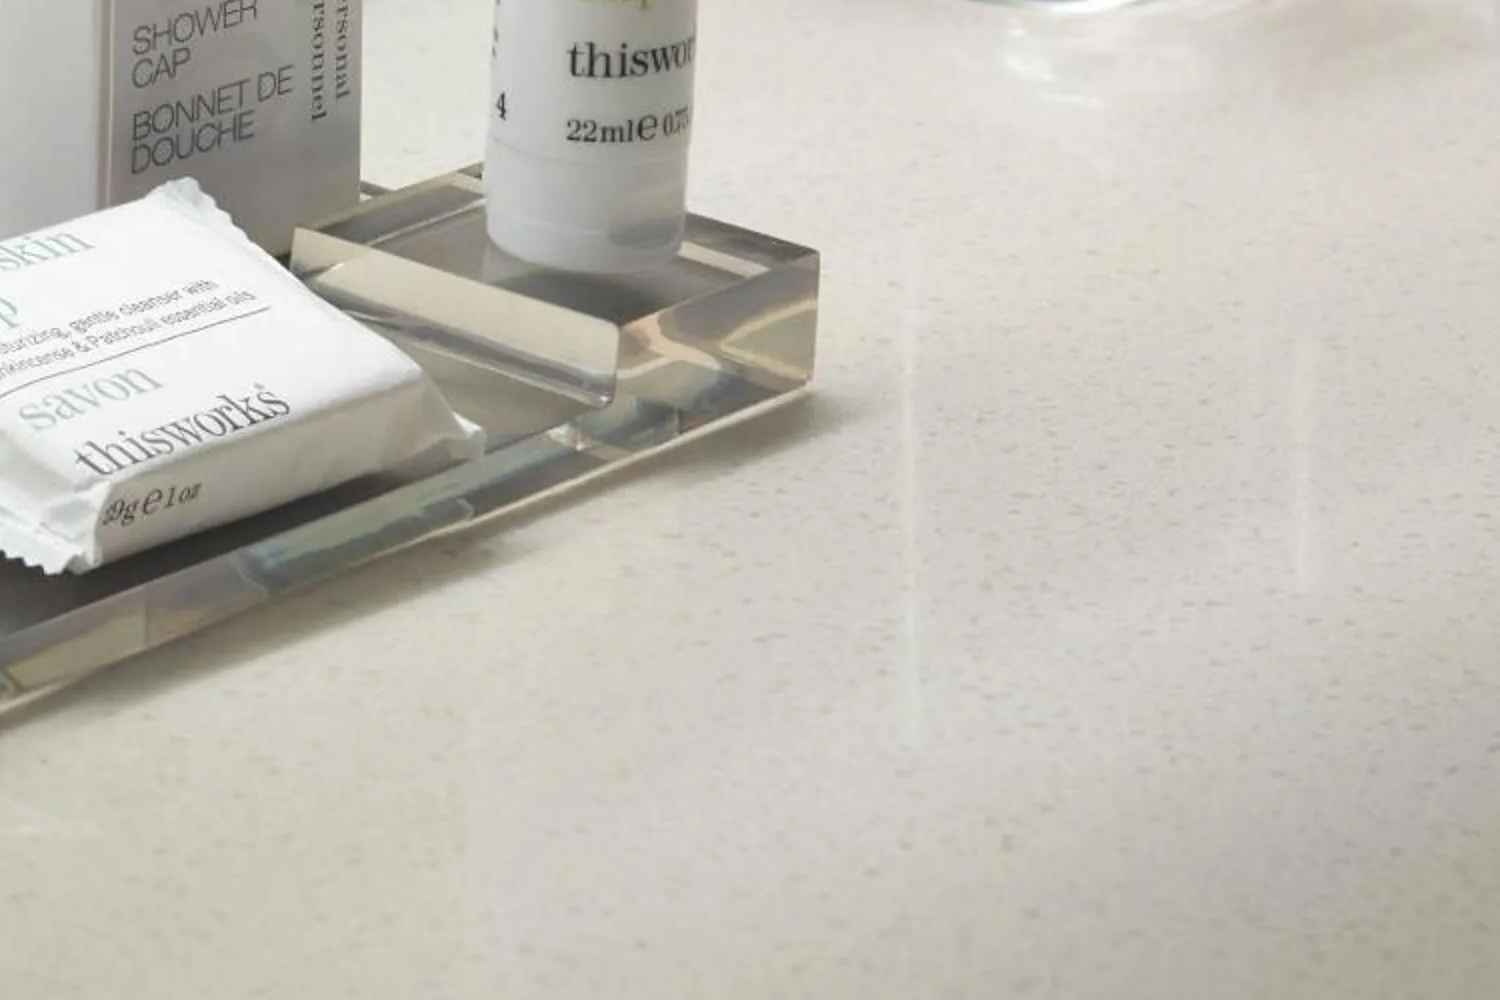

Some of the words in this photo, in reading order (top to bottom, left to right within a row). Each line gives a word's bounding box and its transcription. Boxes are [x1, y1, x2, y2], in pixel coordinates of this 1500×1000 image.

[132, 47, 191, 89] CAP
[132, 78, 252, 142] BONNET
[257, 64, 294, 102] DE
[131, 110, 256, 175] DOUCHE
[18, 366, 164, 431] savon
